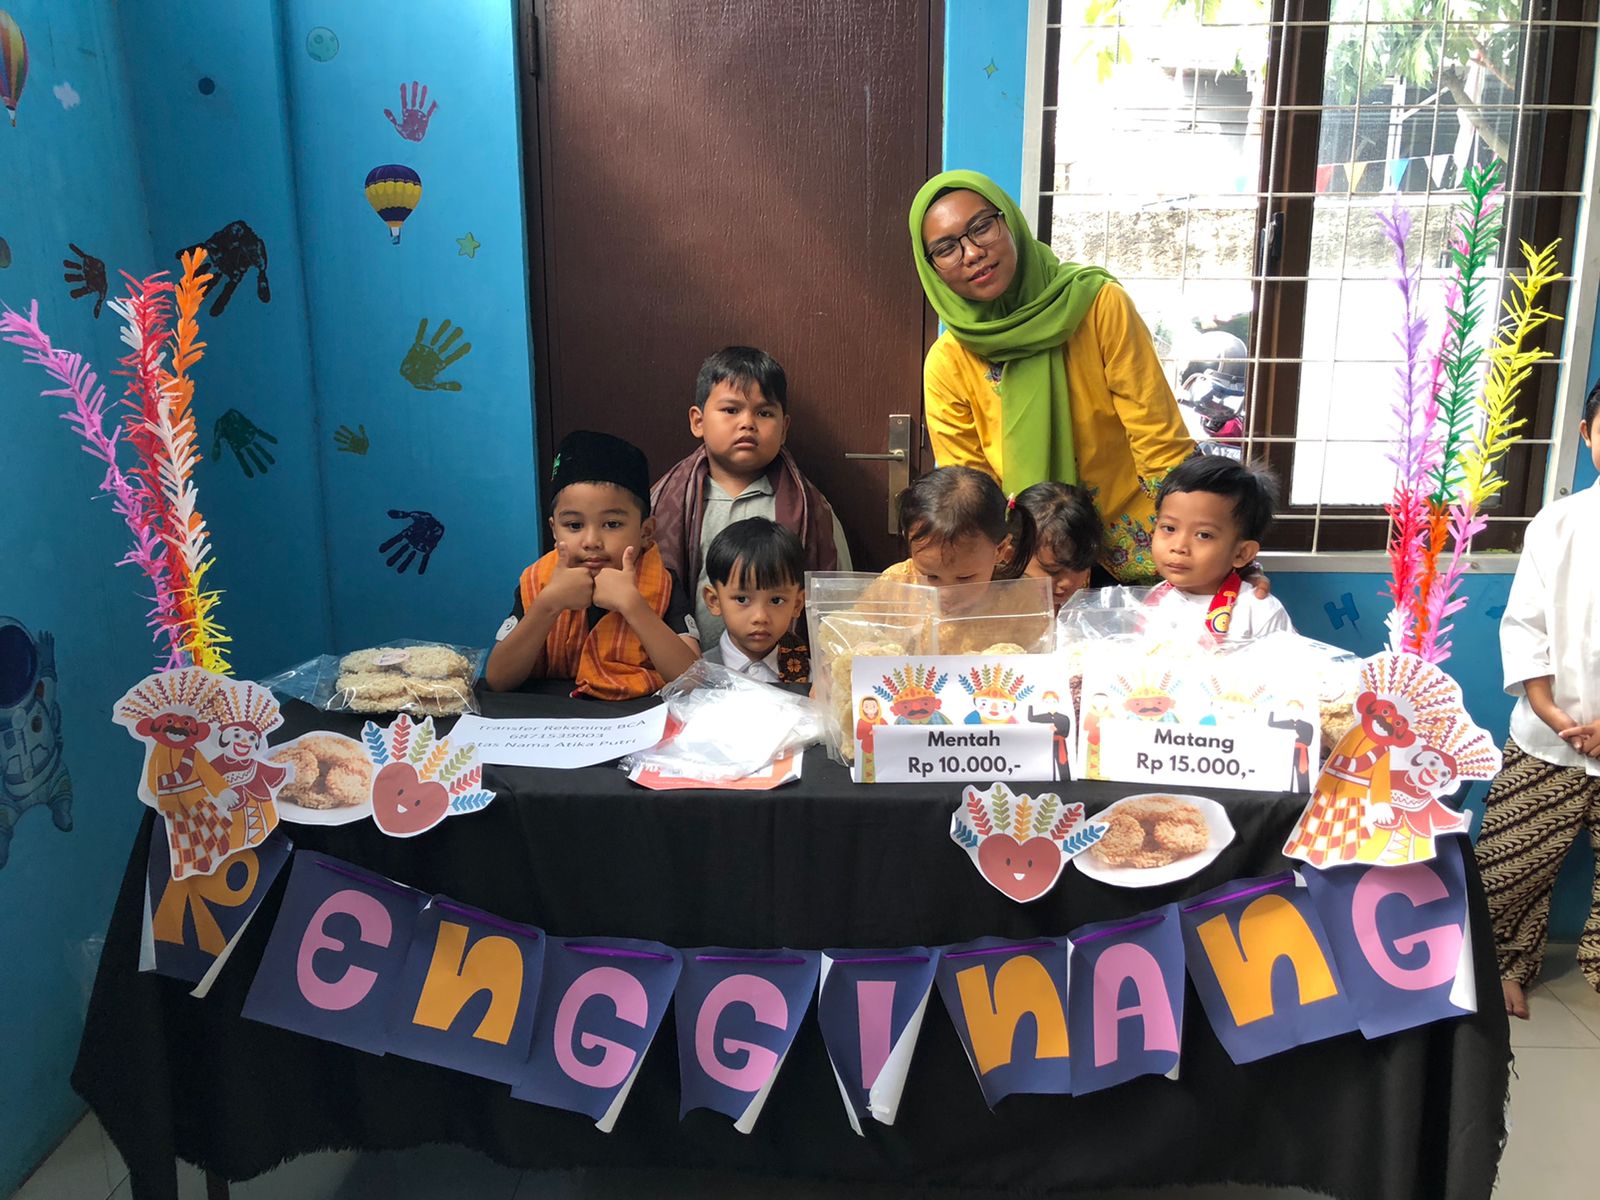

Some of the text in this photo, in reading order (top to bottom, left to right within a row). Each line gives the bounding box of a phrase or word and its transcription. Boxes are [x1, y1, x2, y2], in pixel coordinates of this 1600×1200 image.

[479, 719, 647, 732] Transfer Rekening BCA
[599, 738, 637, 747] Putri
[927, 730, 1001, 747] Mentah
[1153, 728, 1235, 754] Matang
[908, 756, 1021, 778] Rp 10.000,-
[1136, 752, 1256, 780] Rp 15.000,-
